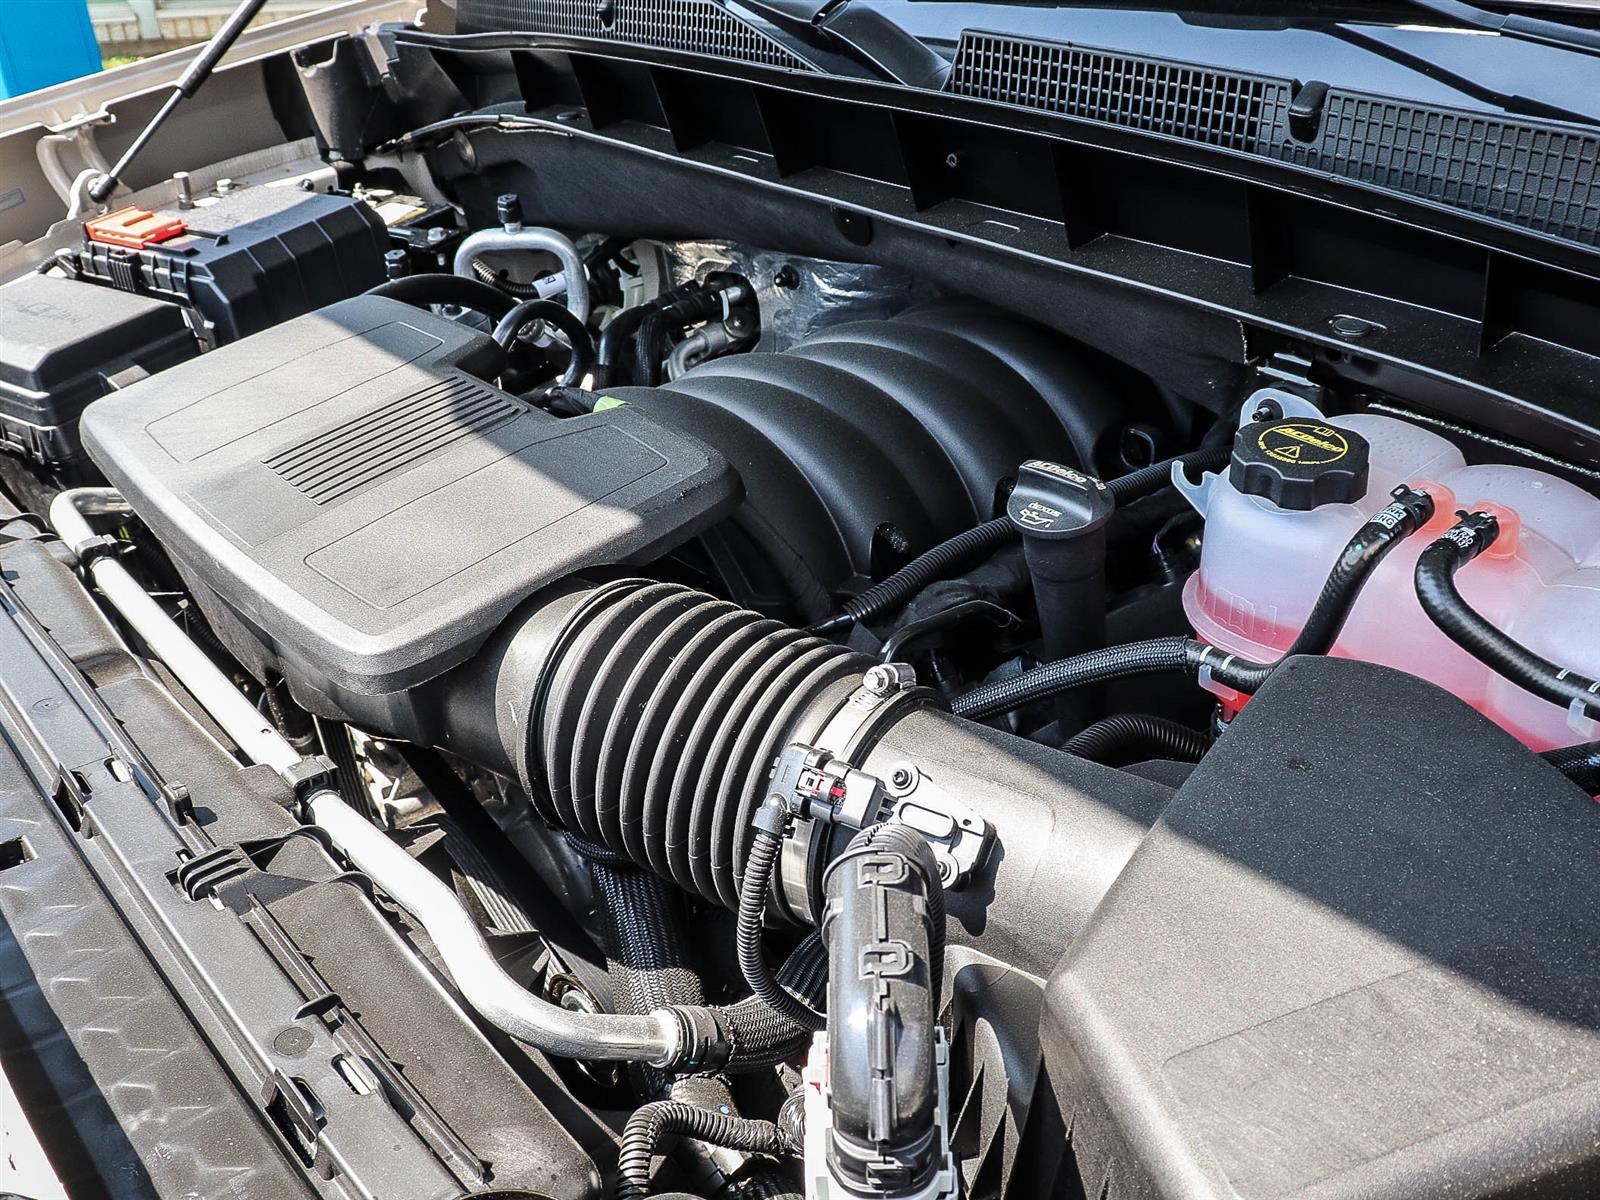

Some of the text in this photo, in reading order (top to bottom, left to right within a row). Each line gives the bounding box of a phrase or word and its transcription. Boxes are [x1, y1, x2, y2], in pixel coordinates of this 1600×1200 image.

[1273, 427, 1345, 452] ACDelco
[1025, 460, 1087, 483] ACDelco
[1028, 501, 1062, 517] dexos
